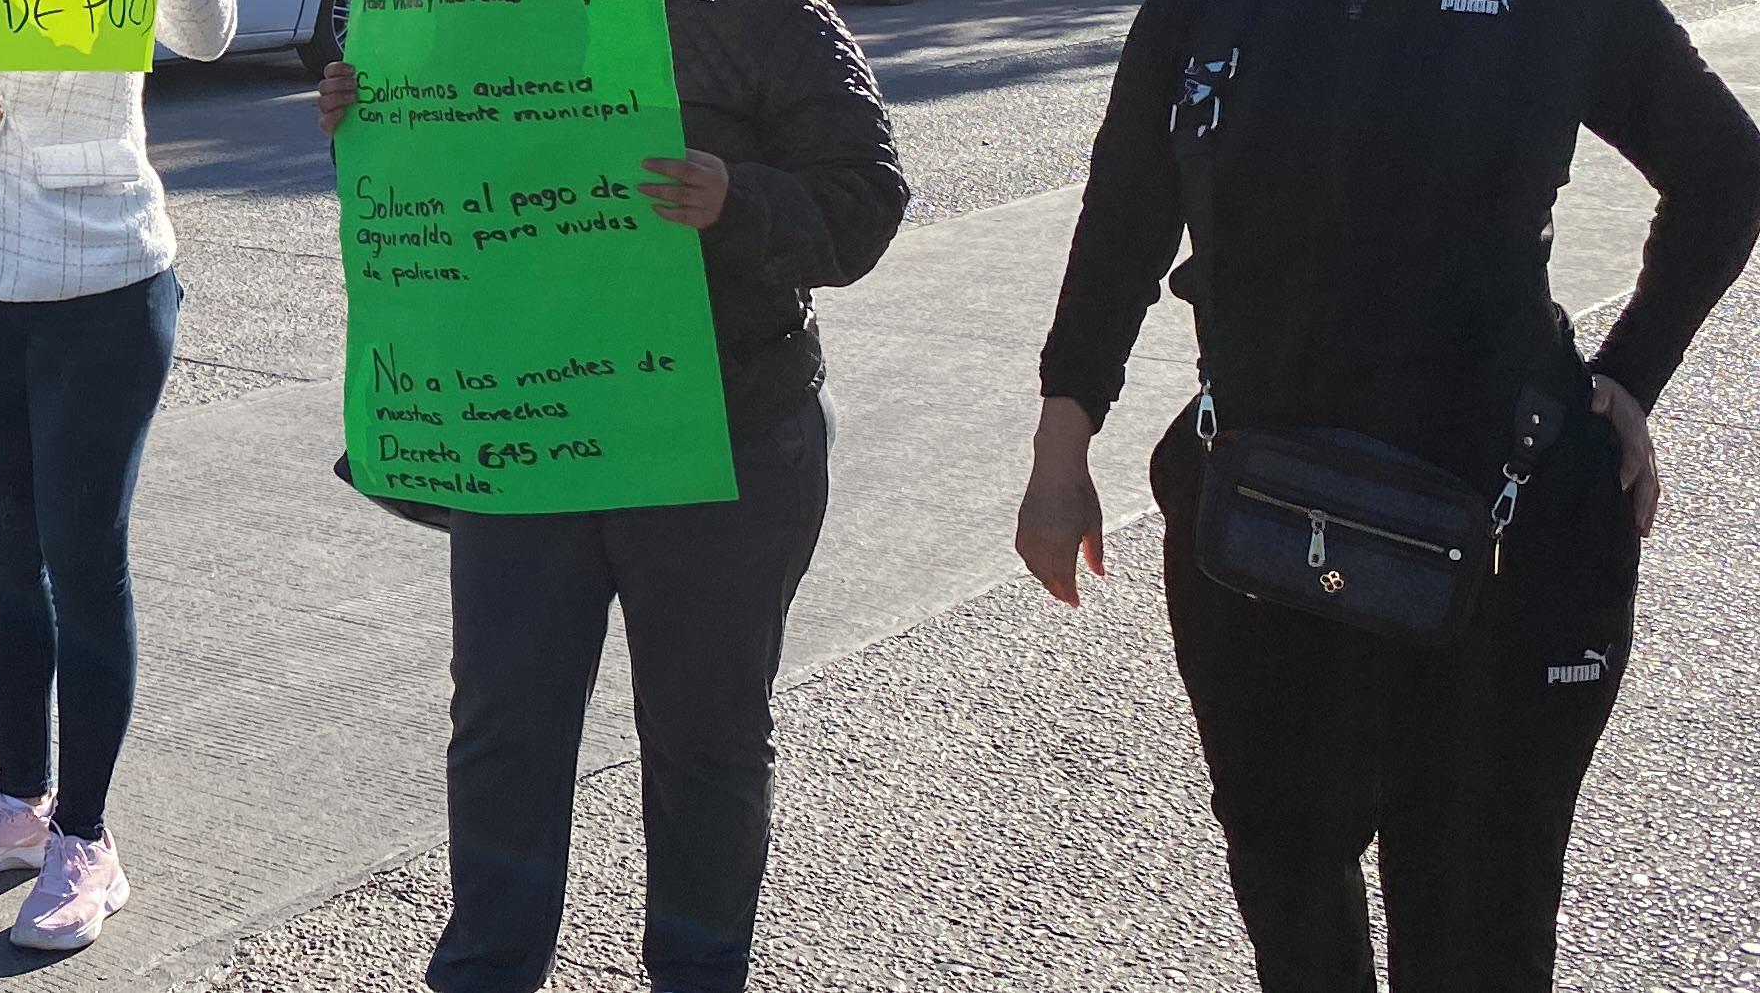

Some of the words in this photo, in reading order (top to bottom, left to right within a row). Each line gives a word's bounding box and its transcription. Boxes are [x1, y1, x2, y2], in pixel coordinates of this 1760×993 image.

[357, 71, 459, 104] Solicitamos
[473, 76, 593, 98] audiencia
[390, 108, 403, 125] el
[408, 104, 501, 130] presidente
[513, 89, 641, 123] municipal
[462, 181, 493, 214] al
[510, 185, 578, 216] pago
[590, 175, 632, 201] de
[356, 224, 453, 258] aguinaldo
[473, 222, 538, 250] para
[556, 212, 638, 236] viudas
[362, 263, 383, 281] de
[372, 342, 414, 395] No
[425, 376, 442, 393] a
[456, 369, 498, 391] los
[516, 358, 616, 388] moches
[636, 350, 676, 373] de
[461, 401, 570, 423] derechos
[377, 433, 462, 464] Decreto
[477, 441, 538, 470] 645
[548, 437, 604, 462] nos
[1547, 663, 1600, 684] PUMA
